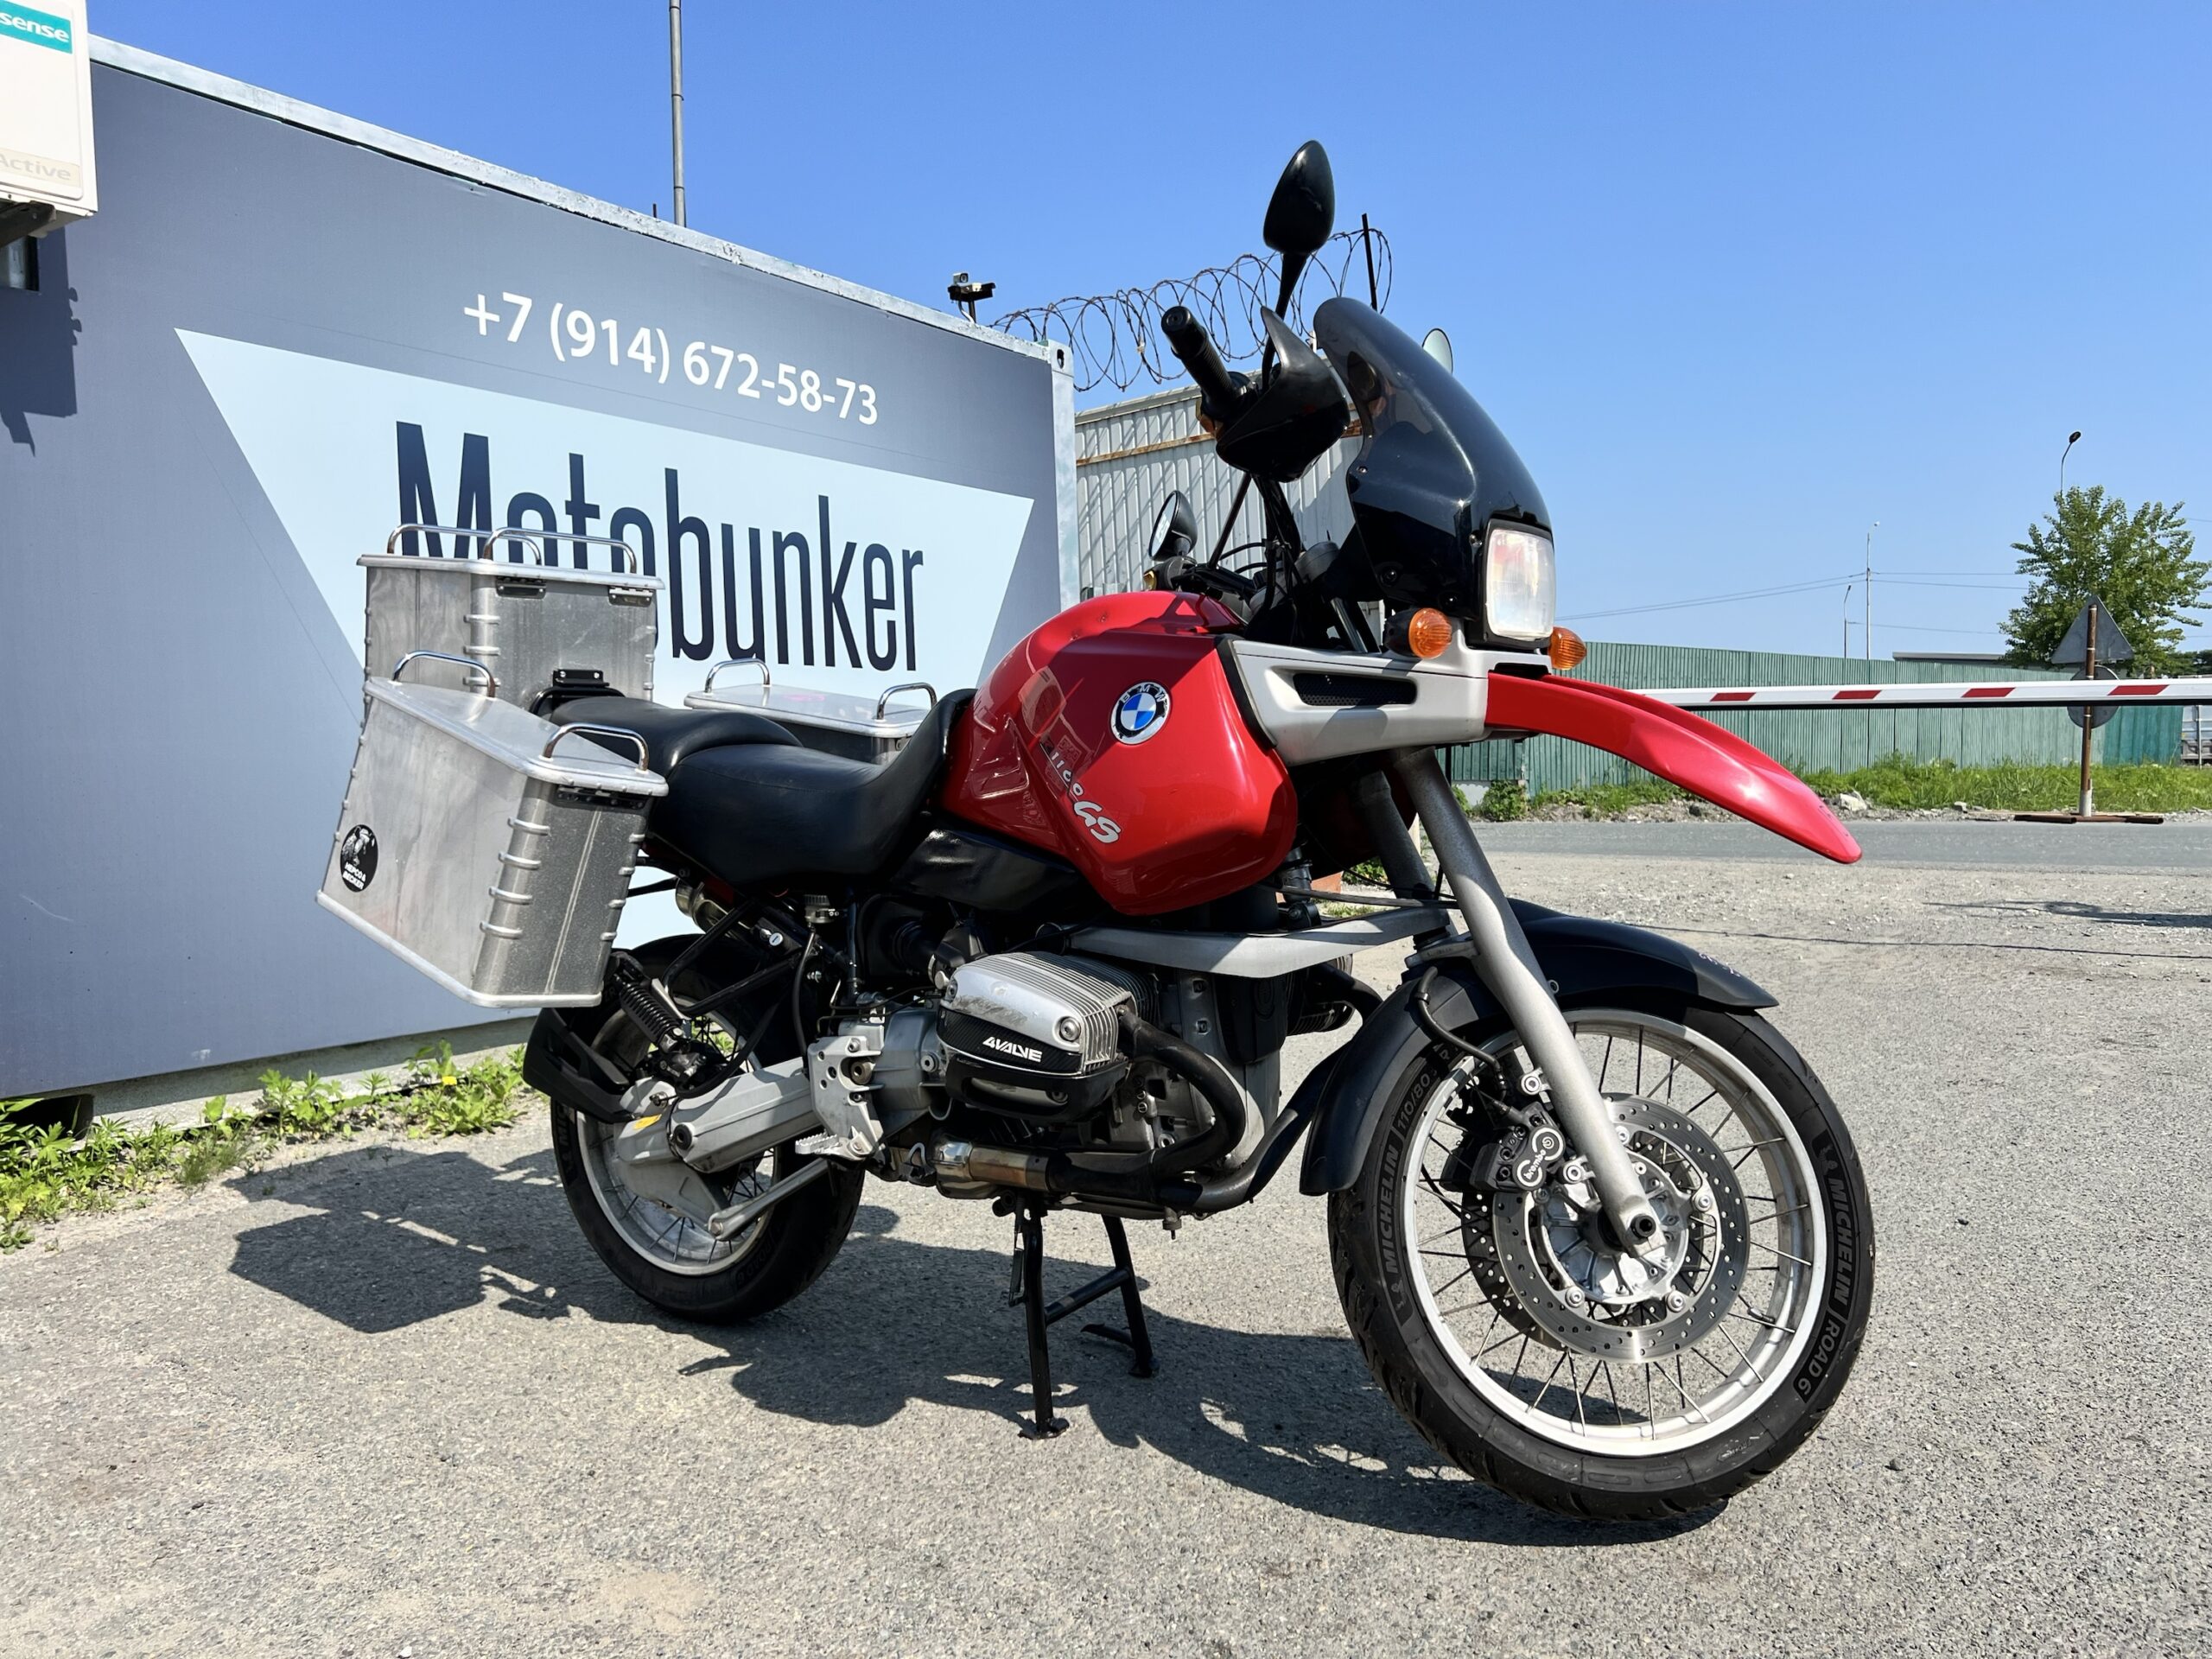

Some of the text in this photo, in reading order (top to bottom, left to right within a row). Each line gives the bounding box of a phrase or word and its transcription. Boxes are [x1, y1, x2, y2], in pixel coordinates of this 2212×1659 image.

[0, 153, 71, 181] Active
[464, 292, 879, 425] +7 (914) 672-58-73
[1120, 683, 1166, 703] BMW
[1073, 800, 1122, 844] GS
[982, 1036, 1043, 1063] 4VALVE
[1380, 1072, 1431, 1274] MICHELIN 110/80
[1522, 1148, 1547, 1180] brembo
[1797, 1178, 1856, 1395] MICHELIN ROAD 6
